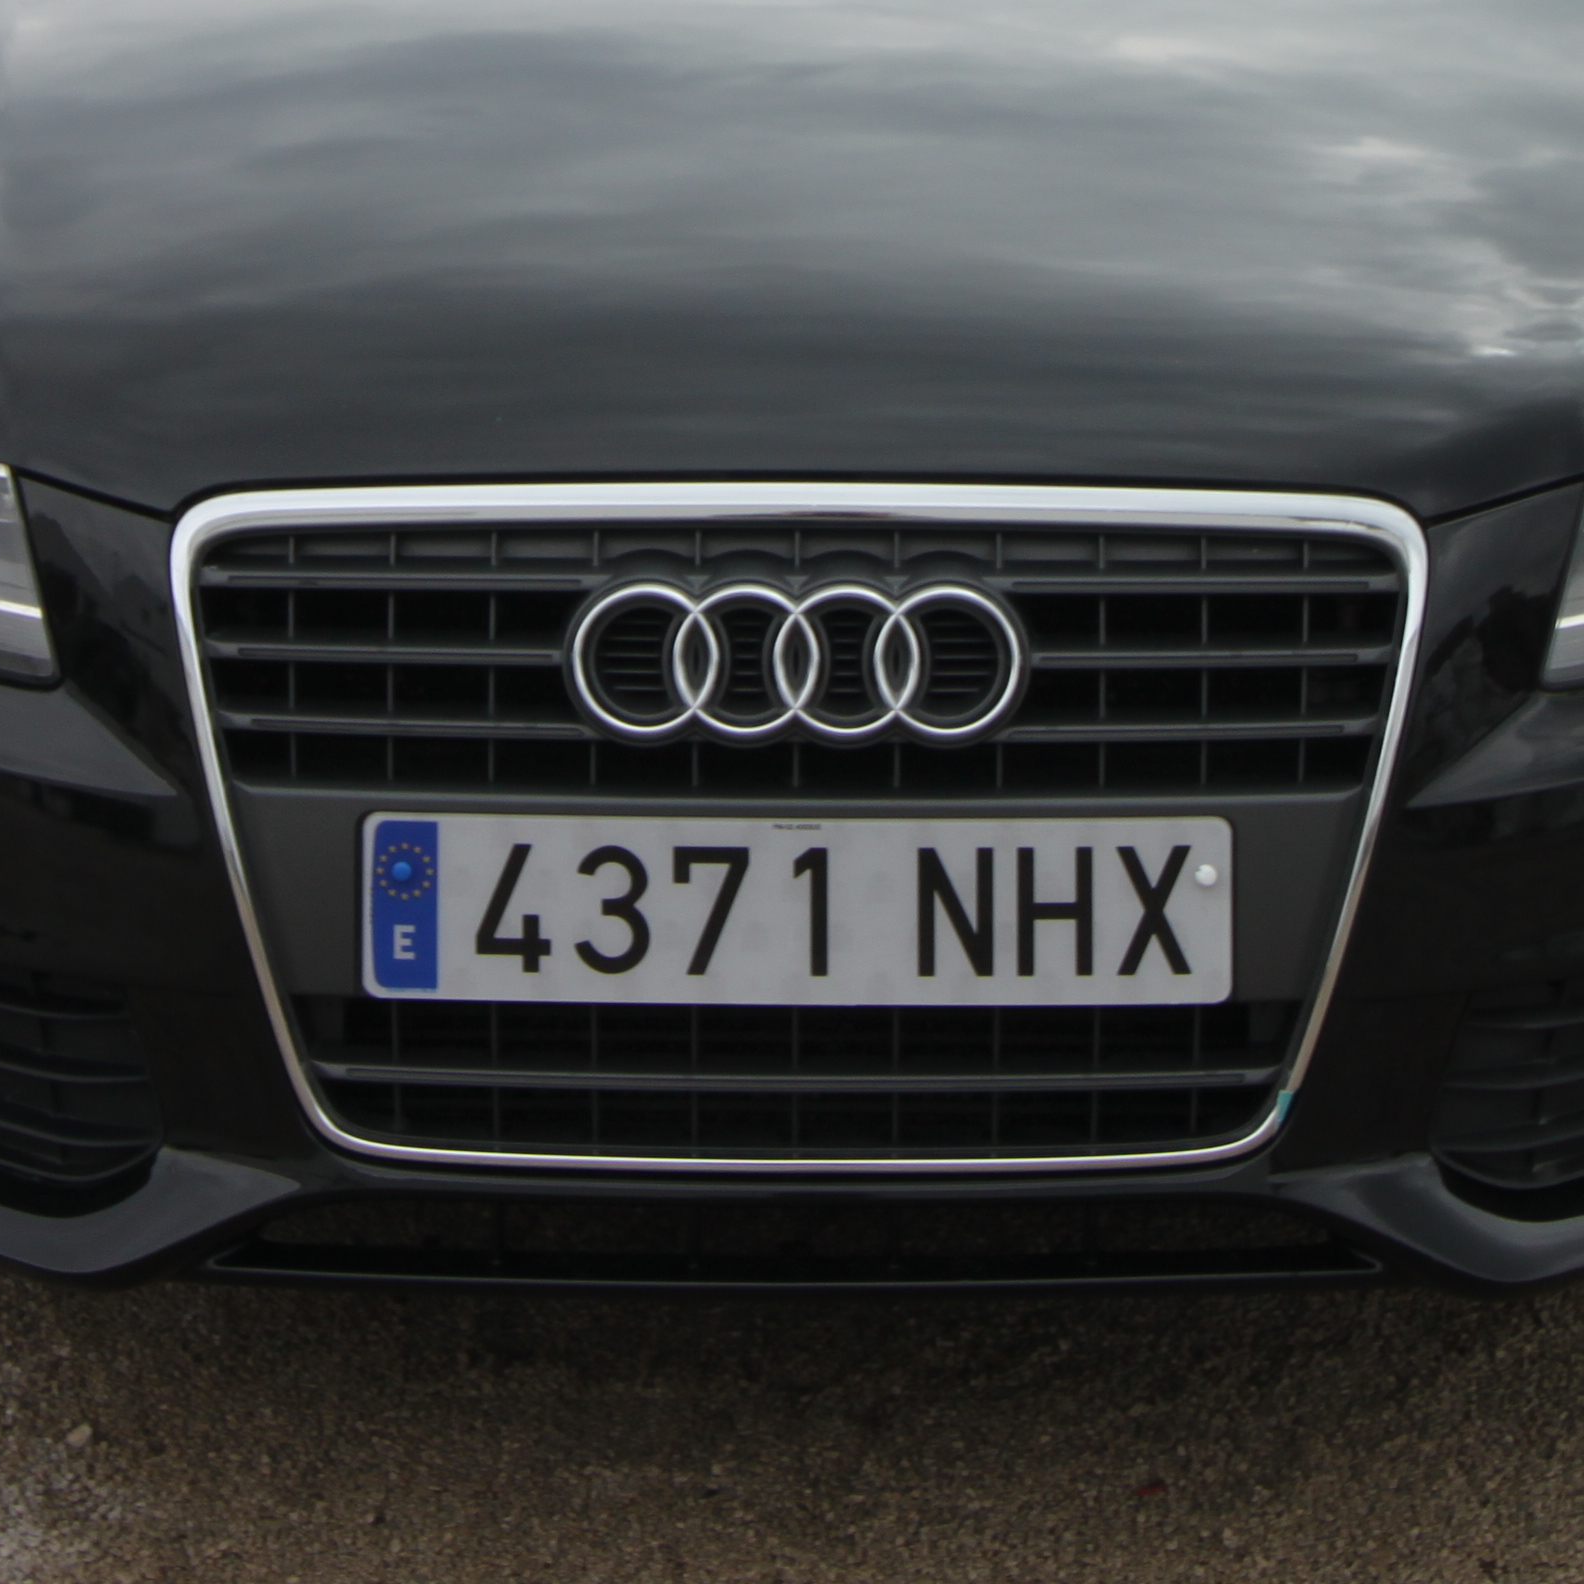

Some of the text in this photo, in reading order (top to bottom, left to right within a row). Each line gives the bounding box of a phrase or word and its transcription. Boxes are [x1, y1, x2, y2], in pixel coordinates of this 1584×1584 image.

[393, 924, 416, 960] E
[475, 844, 1193, 977] 4371 NHX
